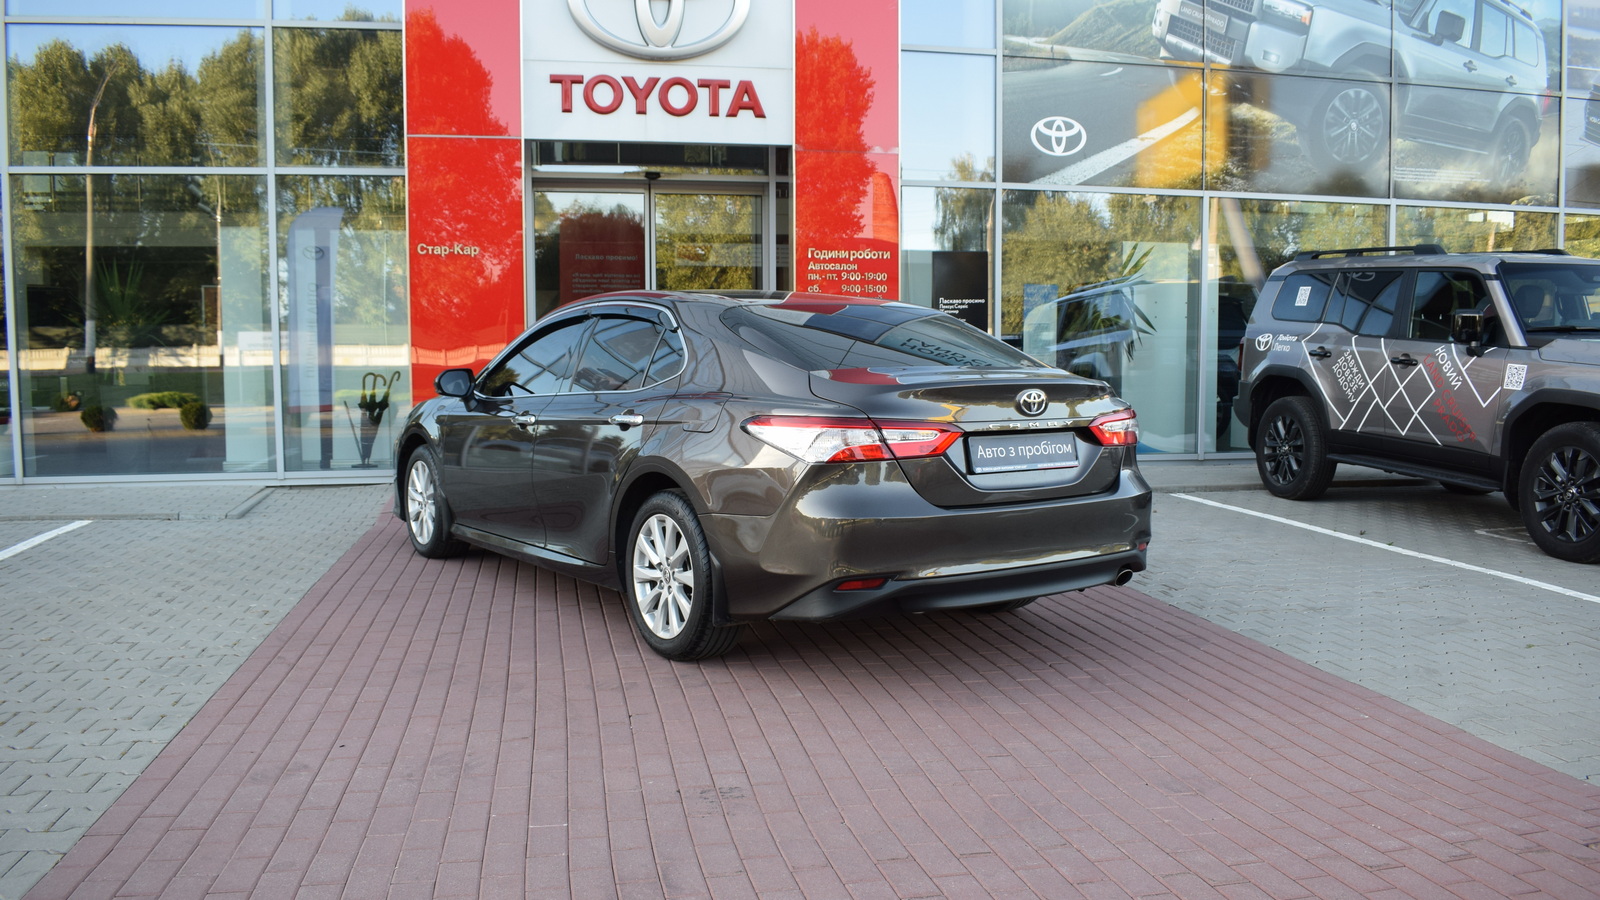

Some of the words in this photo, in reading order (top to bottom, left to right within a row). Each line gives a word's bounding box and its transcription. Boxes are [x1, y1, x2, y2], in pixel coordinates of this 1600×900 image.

[549, 74, 767, 119] TOYOTA
[416, 243, 480, 258] Стар-Кар
[807, 247, 849, 260] Години
[850, 248, 891, 261] роботи
[807, 261, 858, 270] Автосалон
[841, 272, 888, 281] 9:00-19:00
[807, 284, 822, 293] сб.
[841, 284, 888, 293] 9:00-15:00
[1273, 342, 1291, 352] Легко
[1337, 356, 1359, 393] ДОВЕЗЕ
[1343, 348, 1365, 389] ЗАВЖДИ
[1434, 344, 1463, 391] НОВИЙ
[1332, 363, 1356, 403] ДОДОМУ
[1423, 353, 1445, 388] LAND
[1441, 389, 1477, 442] CRUISER
[988, 420, 1074, 429] CAMRY
[1432, 398, 1465, 442] PRADO
[977, 444, 1006, 459] Авто
[1008, 446, 1016, 457] з
[1018, 440, 1072, 459] пробігом
